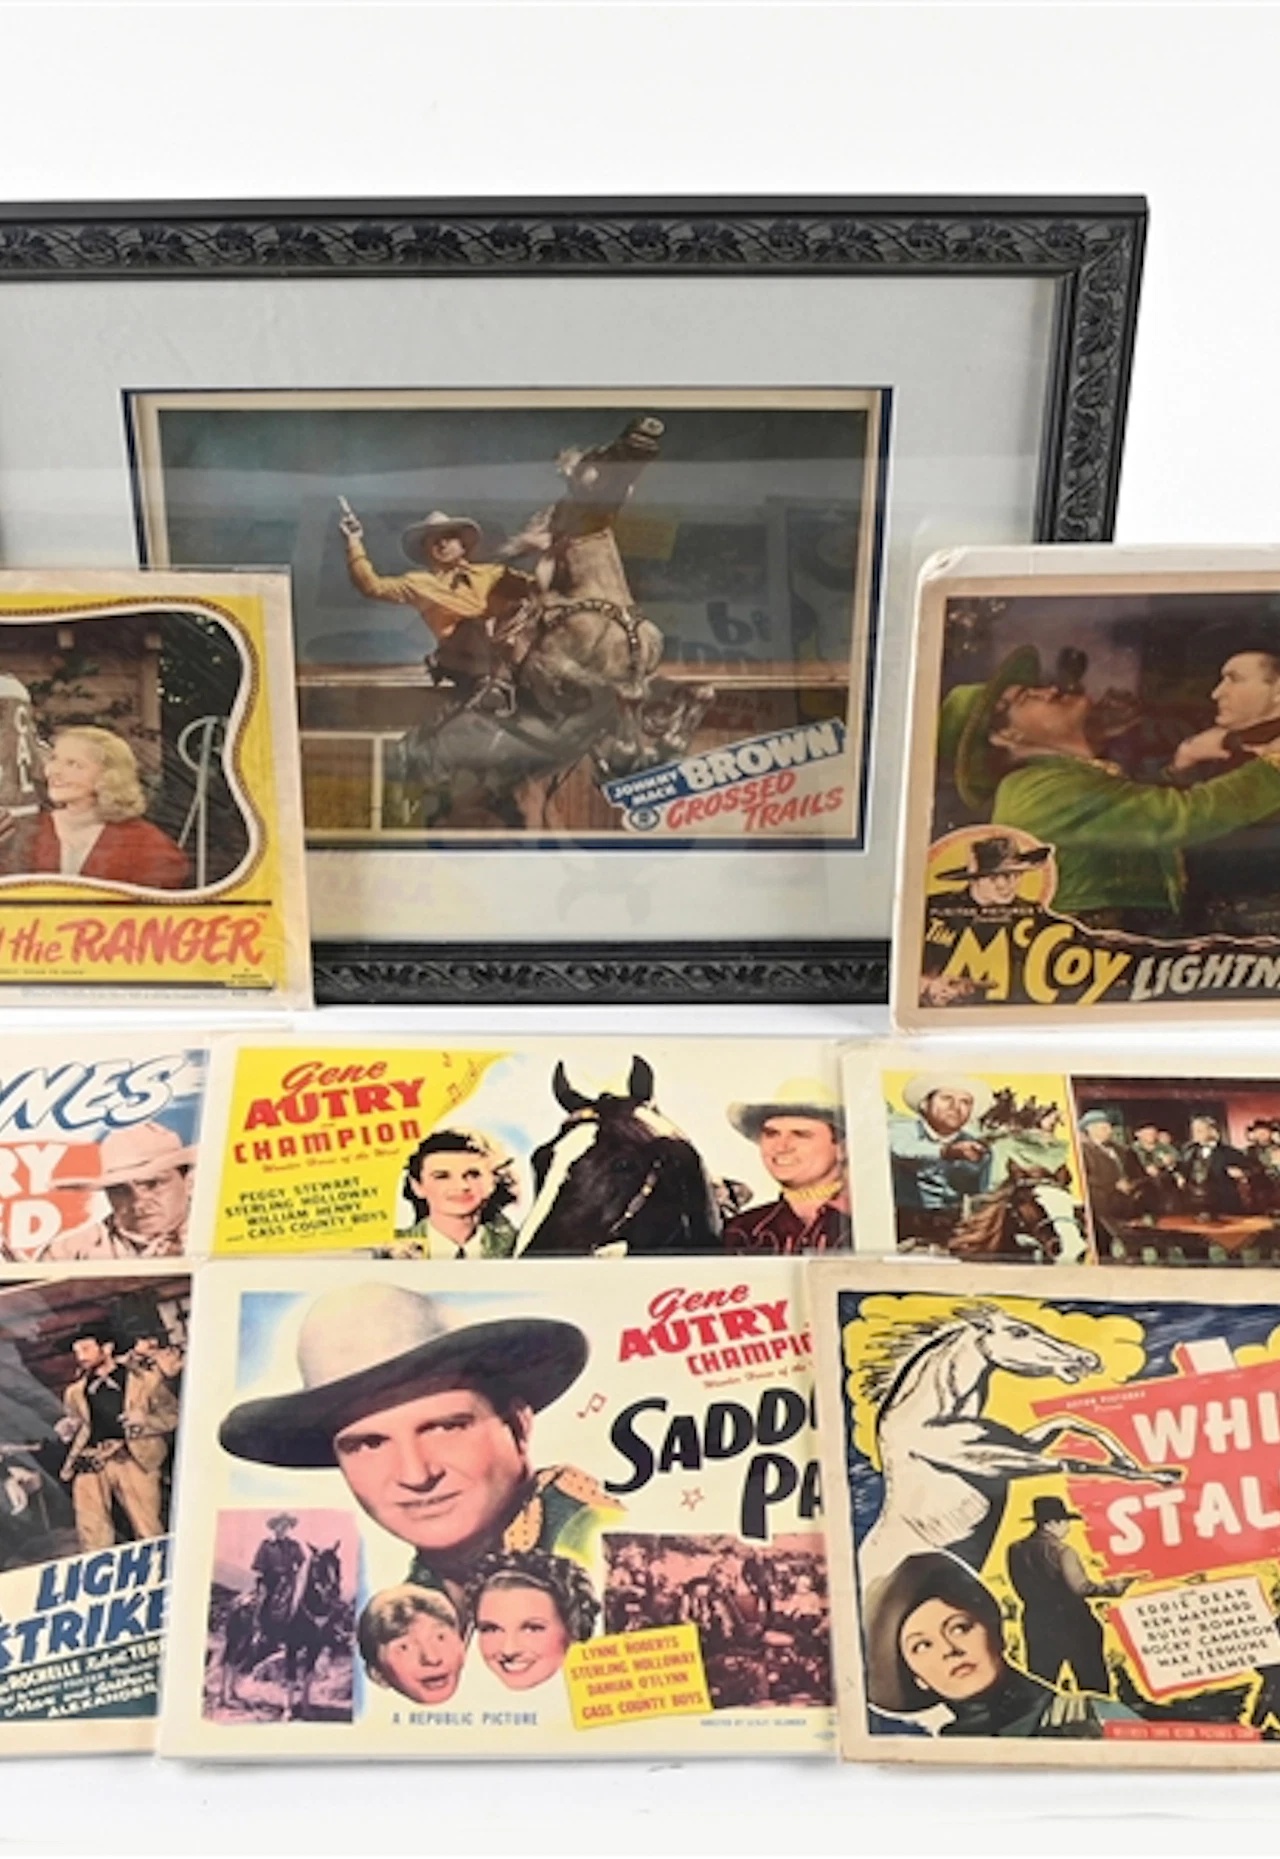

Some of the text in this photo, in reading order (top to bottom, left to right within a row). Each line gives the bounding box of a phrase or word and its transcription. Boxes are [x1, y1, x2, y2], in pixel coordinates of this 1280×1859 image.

[14, 704, 34, 794] CAL
[679, 720, 839, 791] BROWN
[613, 768, 677, 798] JOHNNY
[630, 783, 676, 805] MACK
[666, 769, 796, 830] CROSSED
[742, 787, 845, 832] TRAILS
[8, 918, 63, 962] the
[281, 1060, 388, 1097] Gene
[244, 1077, 426, 1132] AUTRY
[234, 1119, 420, 1164] CHAMPION
[225, 1187, 379, 1218] STERLING HOLLOWAY
[239, 1176, 360, 1202] PEGGY STEWART
[246, 1202, 361, 1226] WILLIAM HENRY
[247, 1226, 286, 1240] CASS
[290, 1216, 346, 1232] COUNTY
[351, 1209, 388, 1225] BOYS
[648, 1284, 749, 1323] Gene
[619, 1300, 788, 1363] AUTRY
[1136, 1598, 1189, 1616] EDDIE
[1200, 1588, 1247, 1604] DEAN
[1142, 1601, 1252, 1629] KEN MAYNARD
[582, 1636, 680, 1661] LYNNE ROBERTS
[1141, 1624, 1275, 1655] ROCKY CAMERON
[1147, 1627, 1191, 1641] RUTH
[571, 1652, 696, 1681] STERLING HOLLOWAY
[1157, 1639, 1268, 1667] MAX TERHUNE
[1208, 1654, 1257, 1672] ELMER
[8, 1661, 81, 1688] ROCHELLE
[393, 1711, 538, 1726] A REPUBLIC PICTURE
[582, 1691, 705, 1720] CASS COUNTY BOYS
